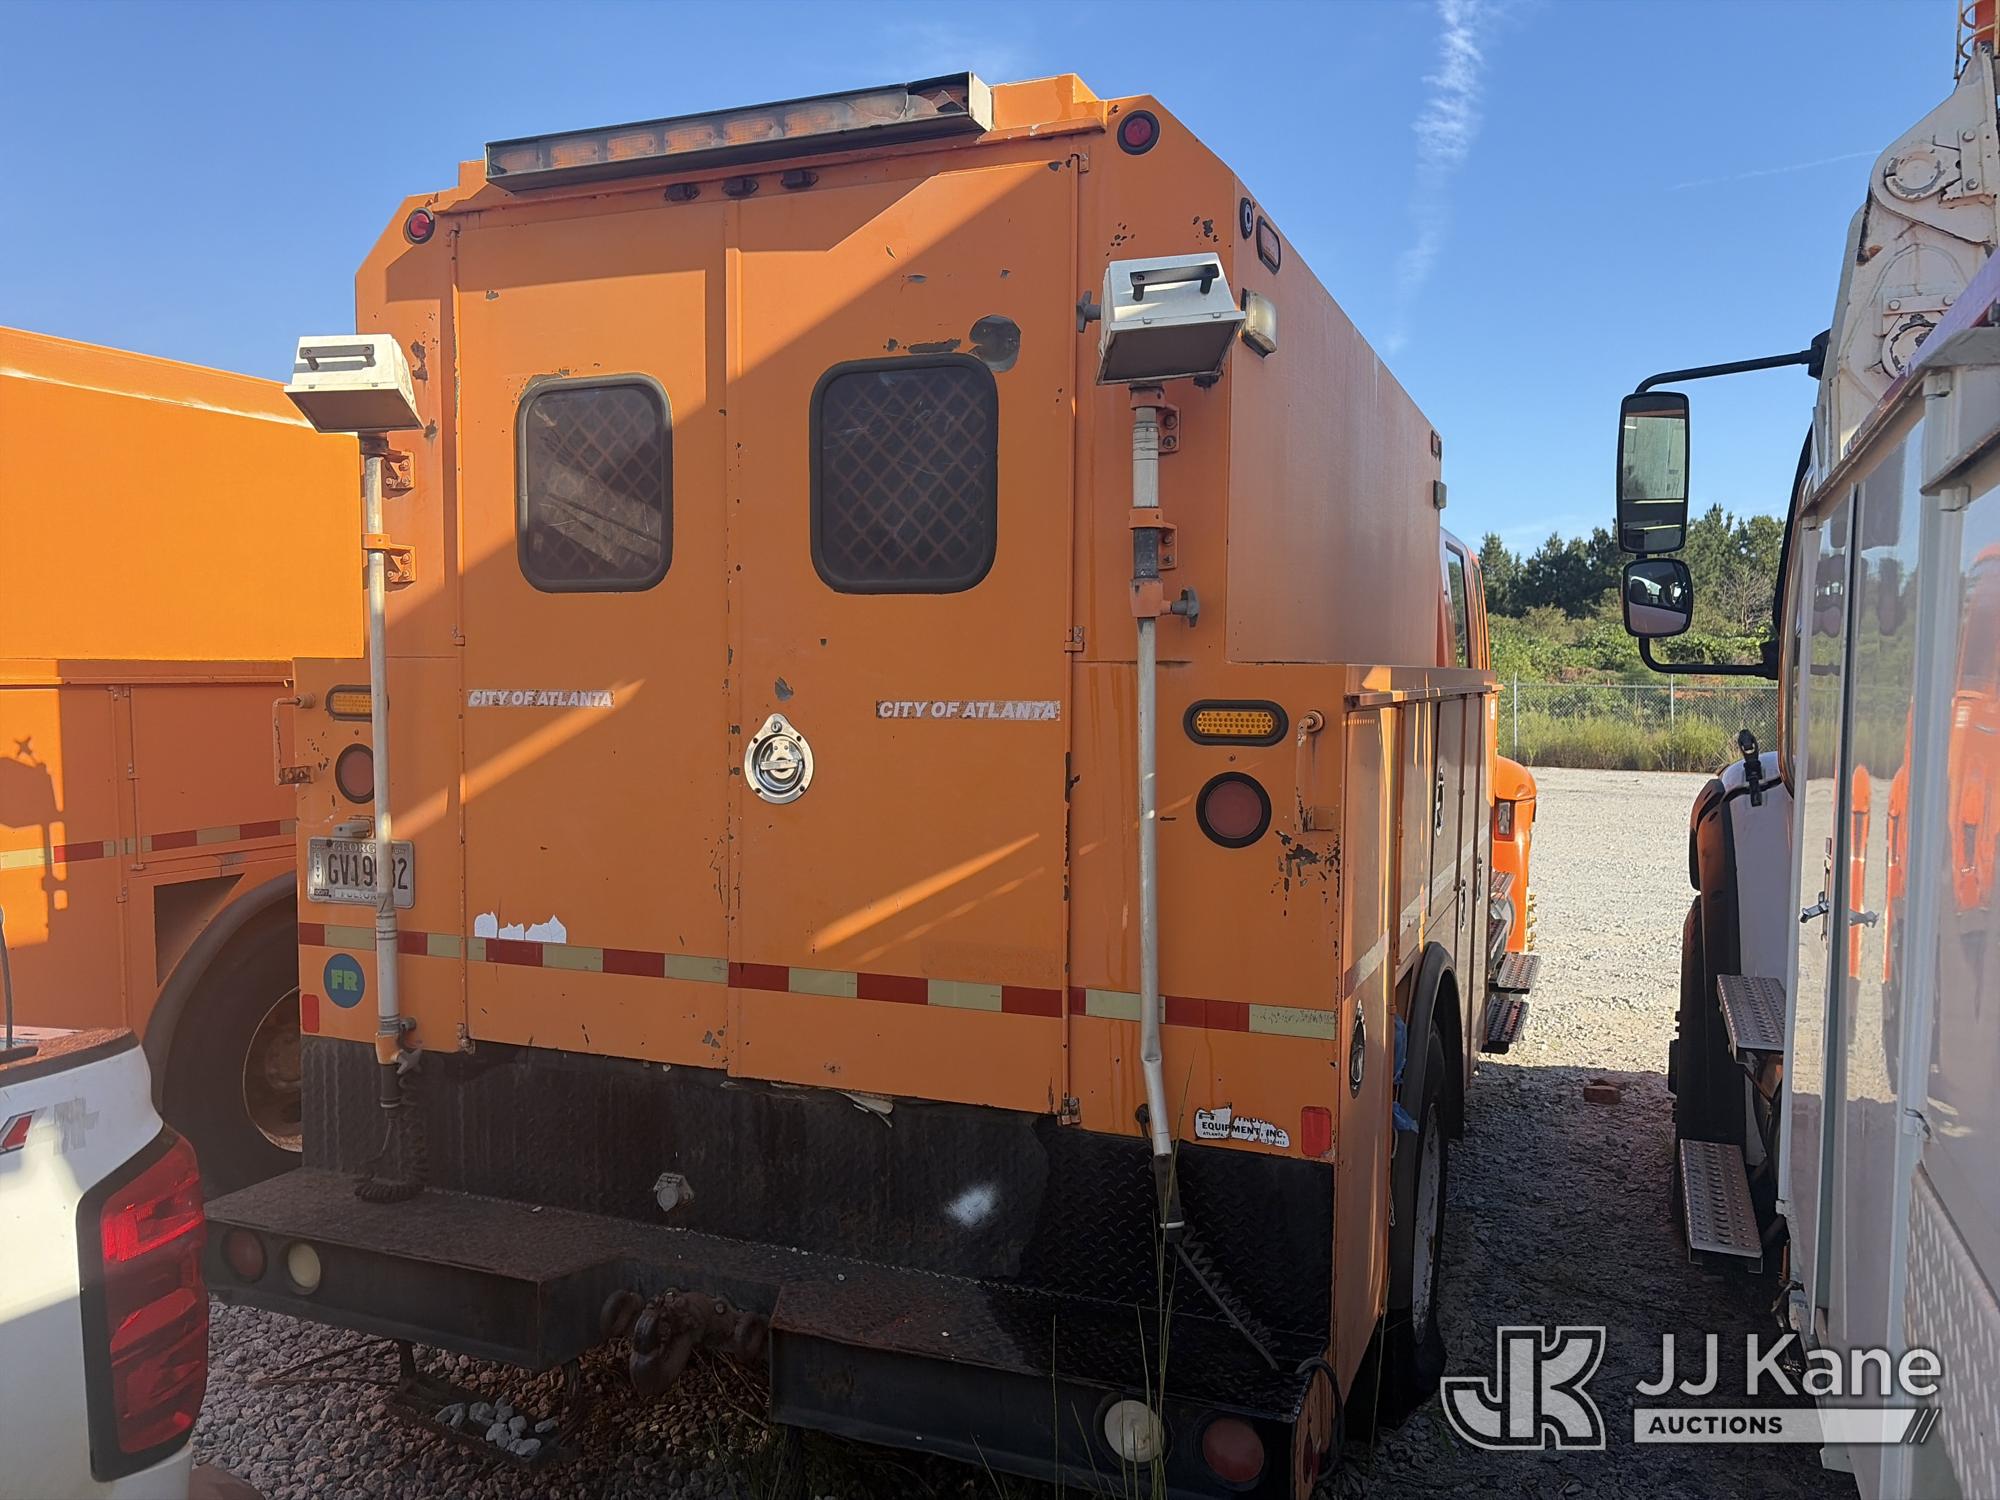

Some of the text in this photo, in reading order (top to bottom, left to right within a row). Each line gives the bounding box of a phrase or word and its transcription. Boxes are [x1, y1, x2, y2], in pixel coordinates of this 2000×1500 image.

[469, 690, 613, 707] CITY OF ATLANTA
[879, 701, 1057, 720] CITY OF ATLANTA
[332, 841, 377, 853] GEORG
[327, 853, 408, 890] GV192
[331, 969, 358, 991] FR
[1265, 1128, 1287, 1140] INC.
